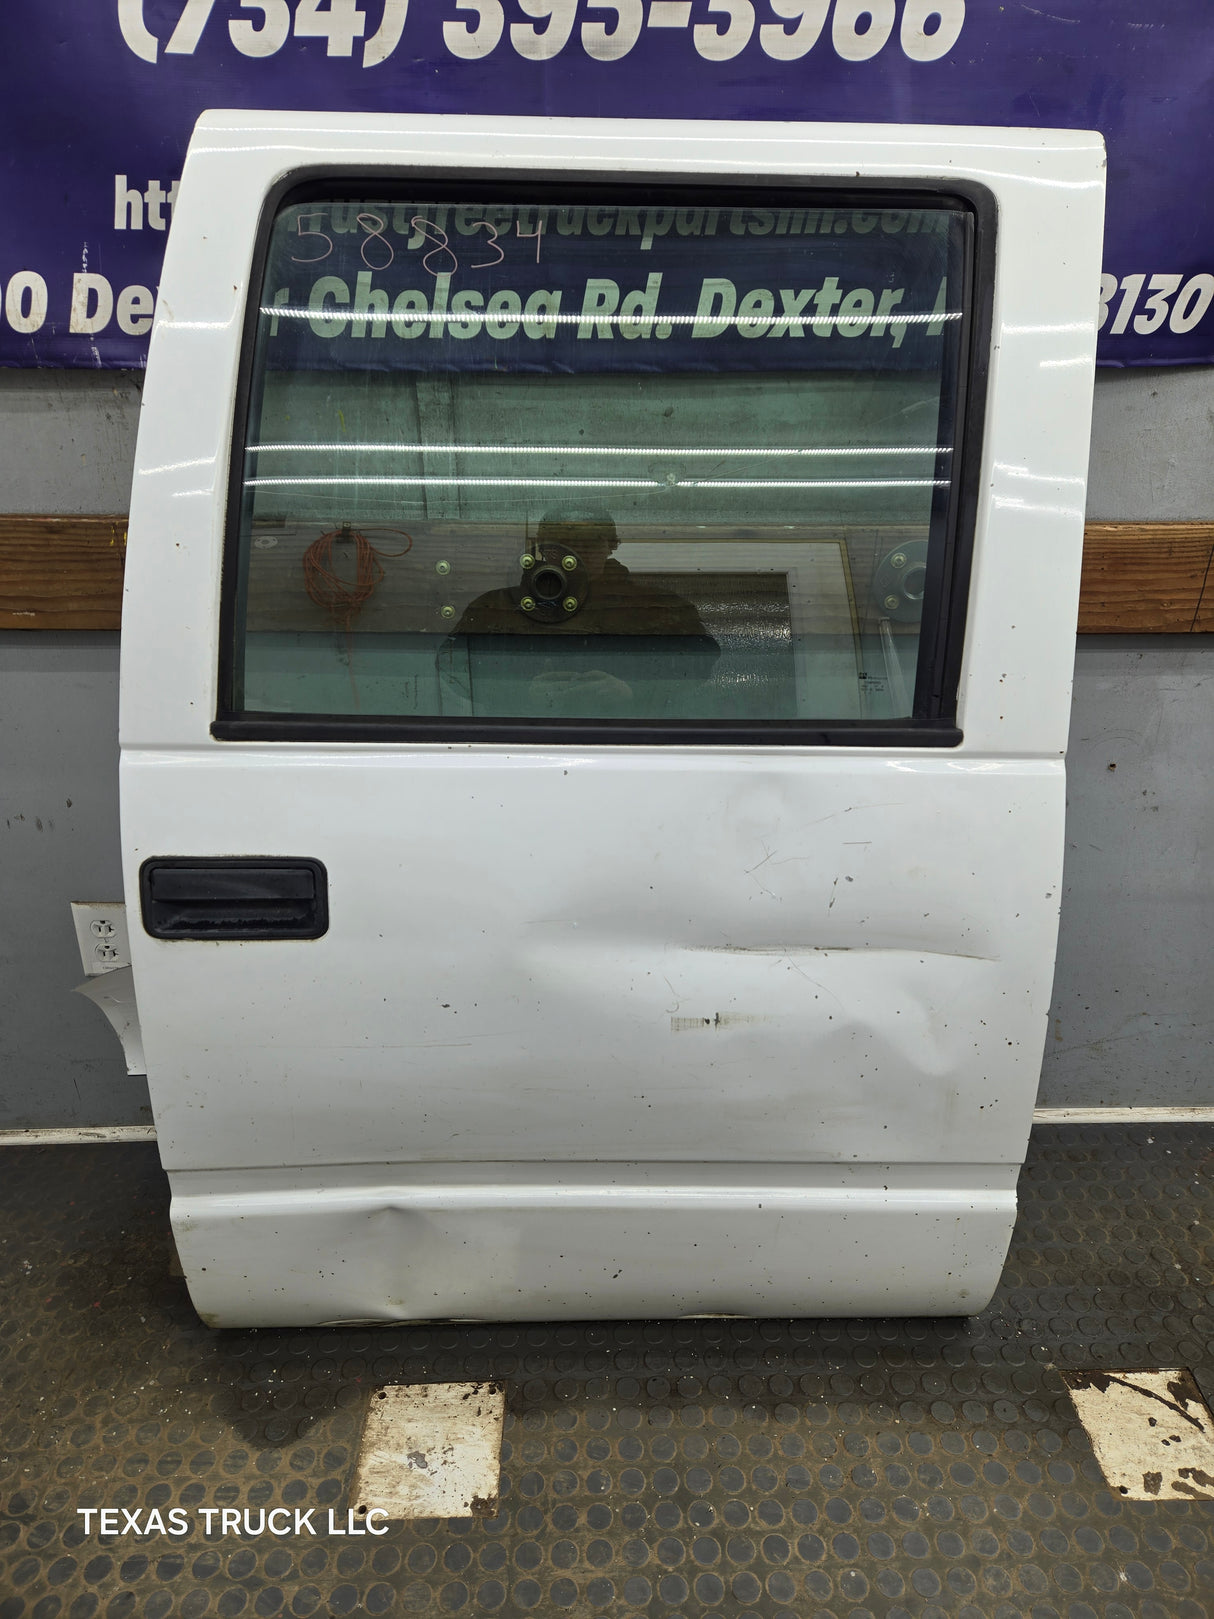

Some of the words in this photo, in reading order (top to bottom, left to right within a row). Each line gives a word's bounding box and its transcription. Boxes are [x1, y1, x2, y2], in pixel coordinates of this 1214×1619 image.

[118, 0, 408, 68] (734)
[308, 271, 563, 340] Chelsea
[577, 272, 673, 339] Rd.
[691, 277, 907, 348] Dexter,
